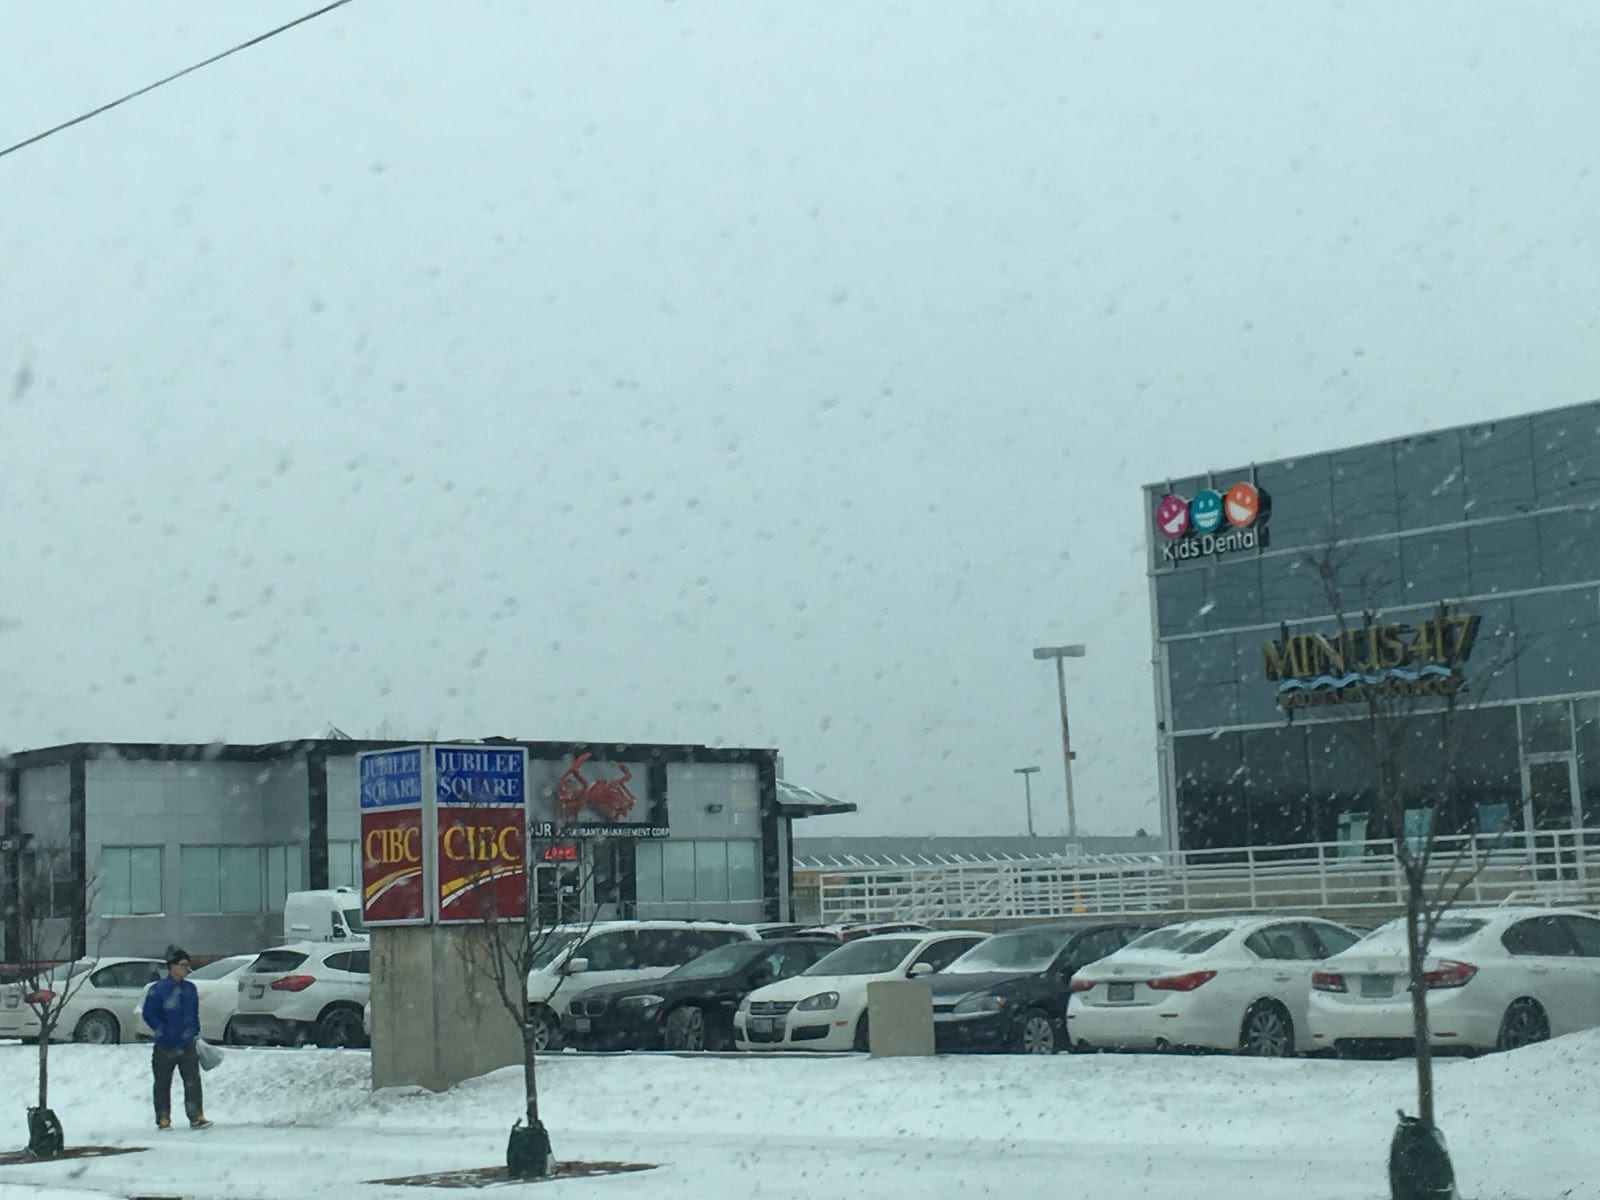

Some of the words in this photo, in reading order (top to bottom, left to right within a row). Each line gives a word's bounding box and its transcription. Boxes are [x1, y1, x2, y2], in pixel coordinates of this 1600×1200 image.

[1163, 538, 1200, 560] Kids
[1202, 526, 1259, 555] Dental
[363, 752, 419, 778] JUBILEE
[438, 751, 521, 773] JUBILEE
[364, 777, 421, 805] SQUARE
[439, 777, 520, 801] SQUARE
[365, 826, 421, 864] CIBC
[443, 825, 521, 861] CIBC
